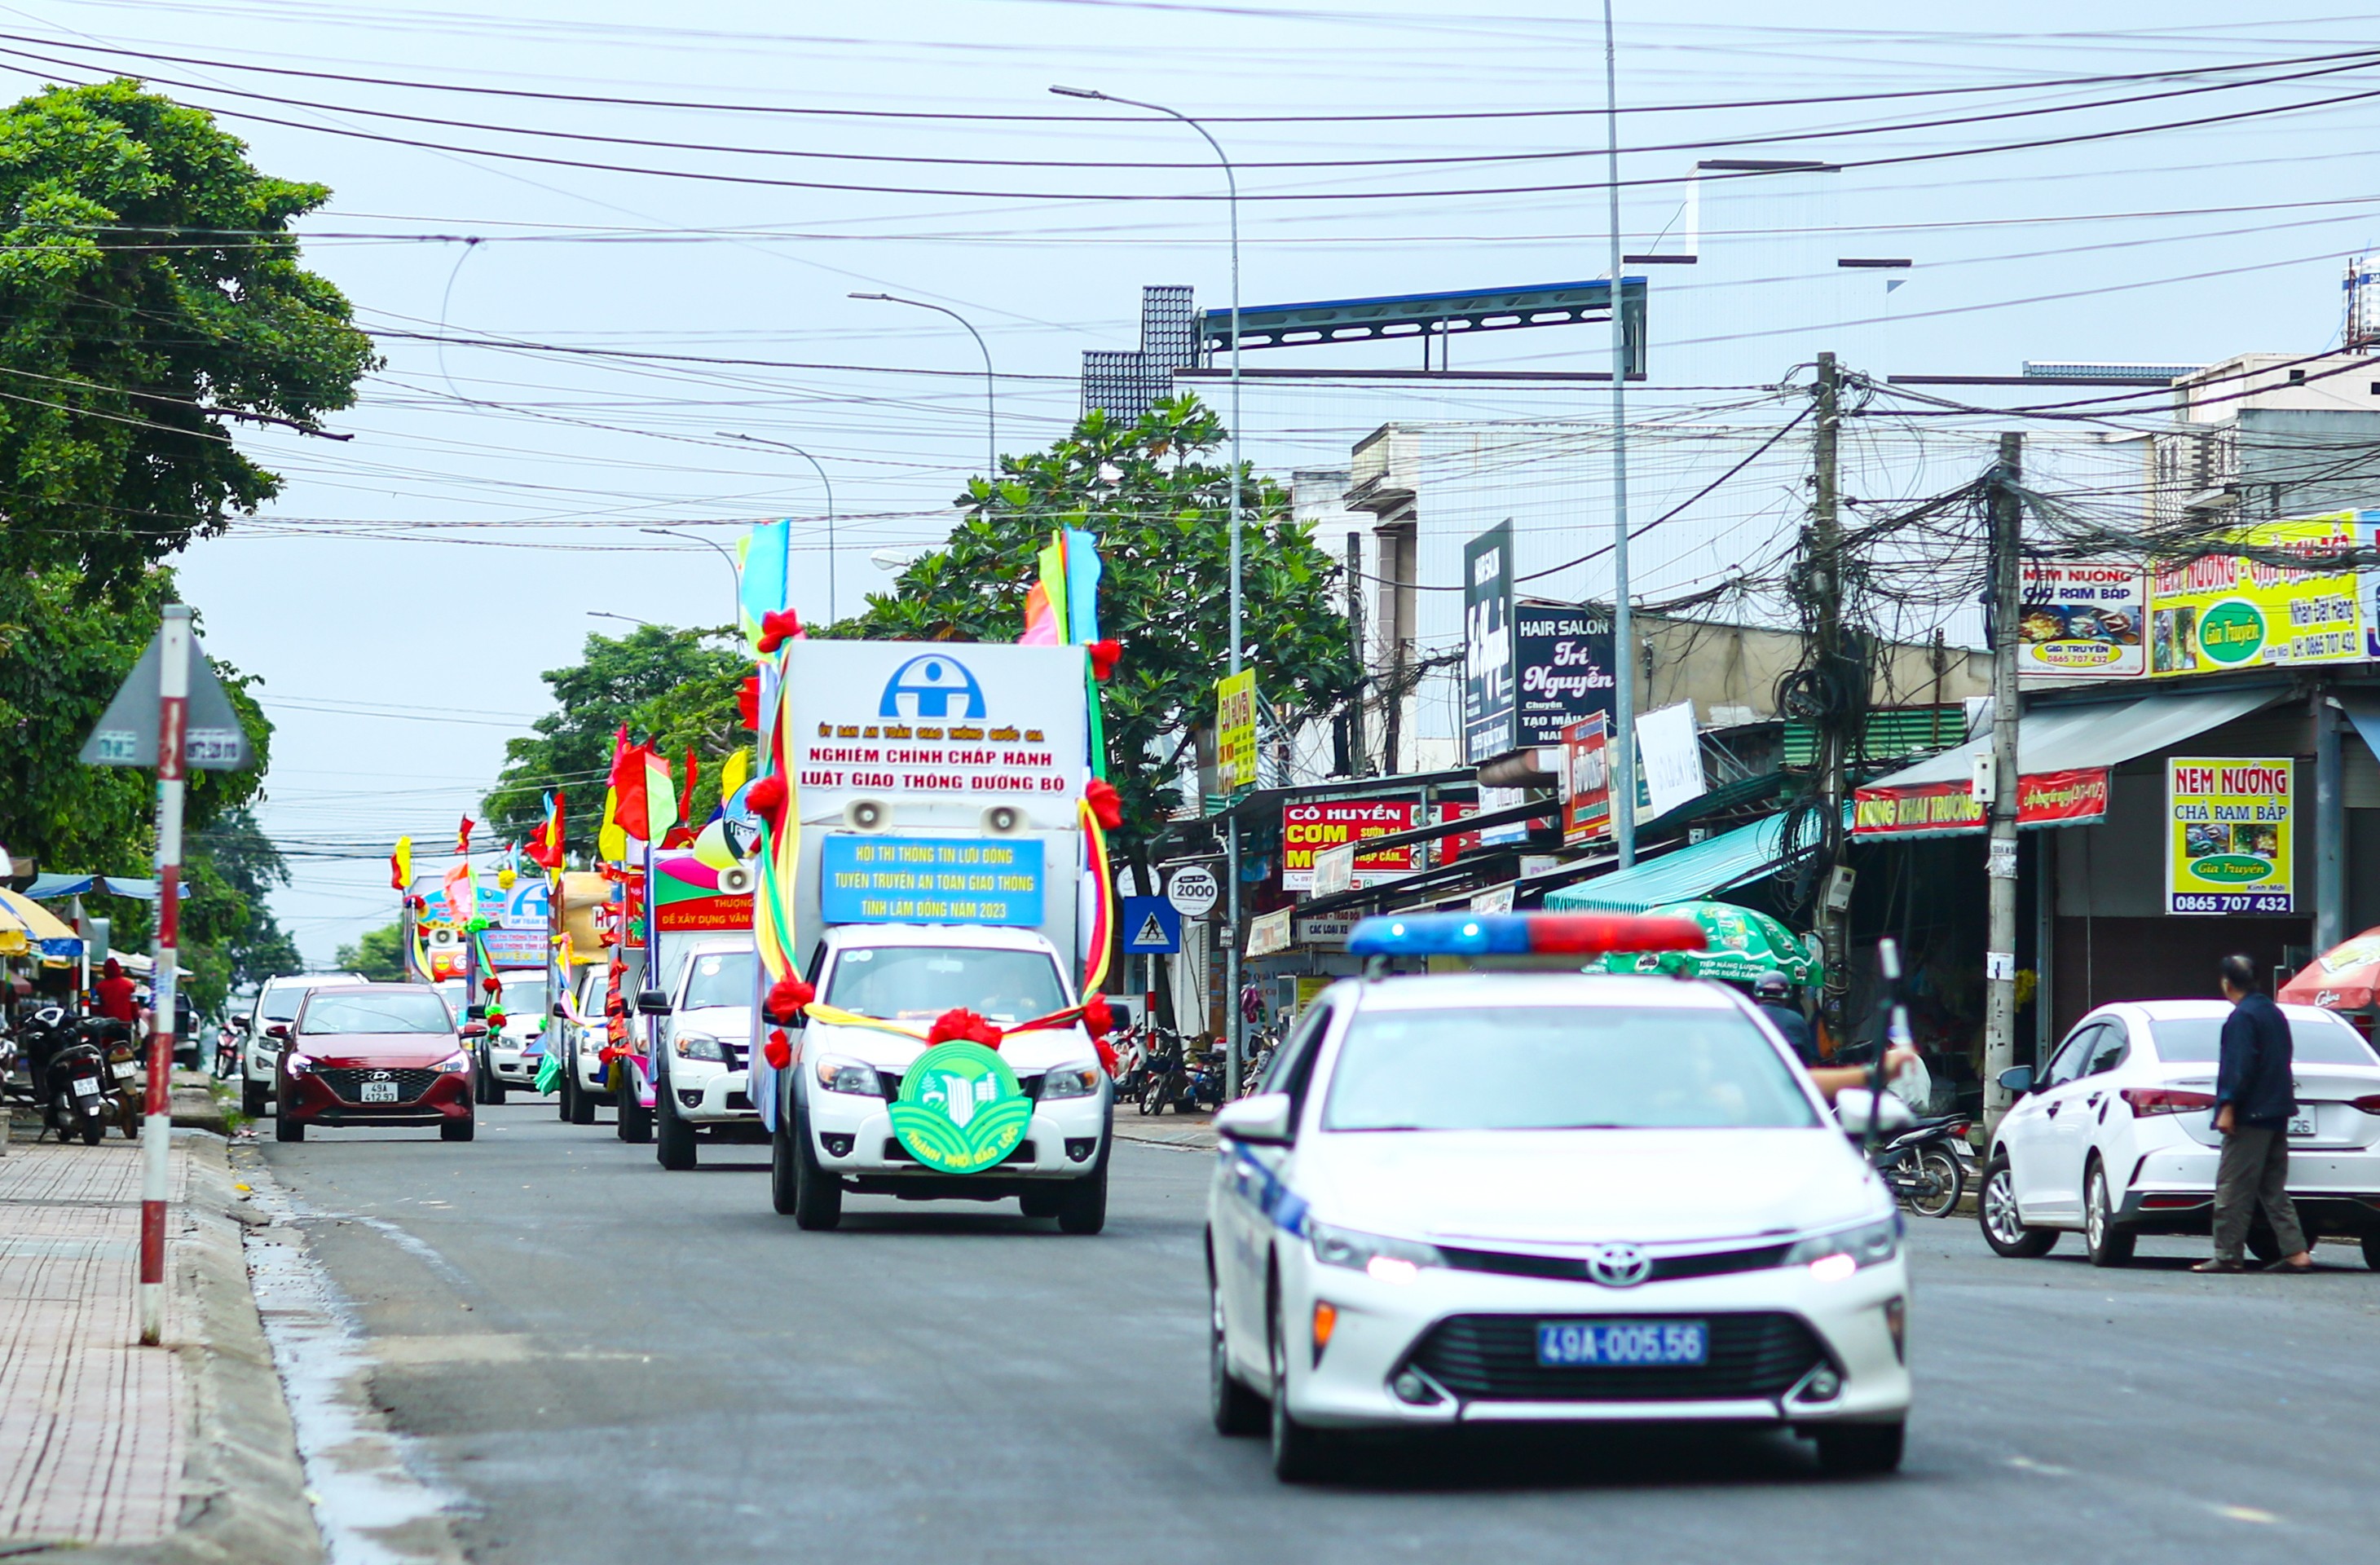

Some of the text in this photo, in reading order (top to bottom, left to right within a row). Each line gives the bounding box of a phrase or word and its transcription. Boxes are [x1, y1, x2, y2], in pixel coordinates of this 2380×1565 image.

[2060, 588, 2095, 599] RAM
[1520, 619, 1608, 636] HAIR SALON
[1523, 666, 1614, 699] Nguyễn
[1526, 701, 1562, 710] Chuyên
[1523, 716, 1548, 728] TẠO
[809, 747, 879, 763] NGHIÊM
[852, 772, 894, 787] GIAO
[903, 773, 963, 790] THÔNG
[2175, 763, 2287, 796] NEM NƯỚNG
[1289, 805, 1400, 821] CÔ HUYỀN
[1898, 797, 1928, 825] KHAI
[2175, 797, 2287, 820] CHẢ RAM BẮP
[1287, 823, 1347, 844] CƠM
[879, 845, 895, 862] THI
[899, 844, 935, 862] THÔNG
[939, 847, 954, 862] TIN
[919, 874, 933, 889] AN
[969, 875, 994, 890] GIAO
[998, 873, 1034, 891] THÔNG
[1177, 884, 1214, 897] 2000
[980, 902, 1007, 918] 2023
[2175, 897, 2287, 911] 0865 707 432
[1544, 1326, 1702, 1362] 49A-005.56
